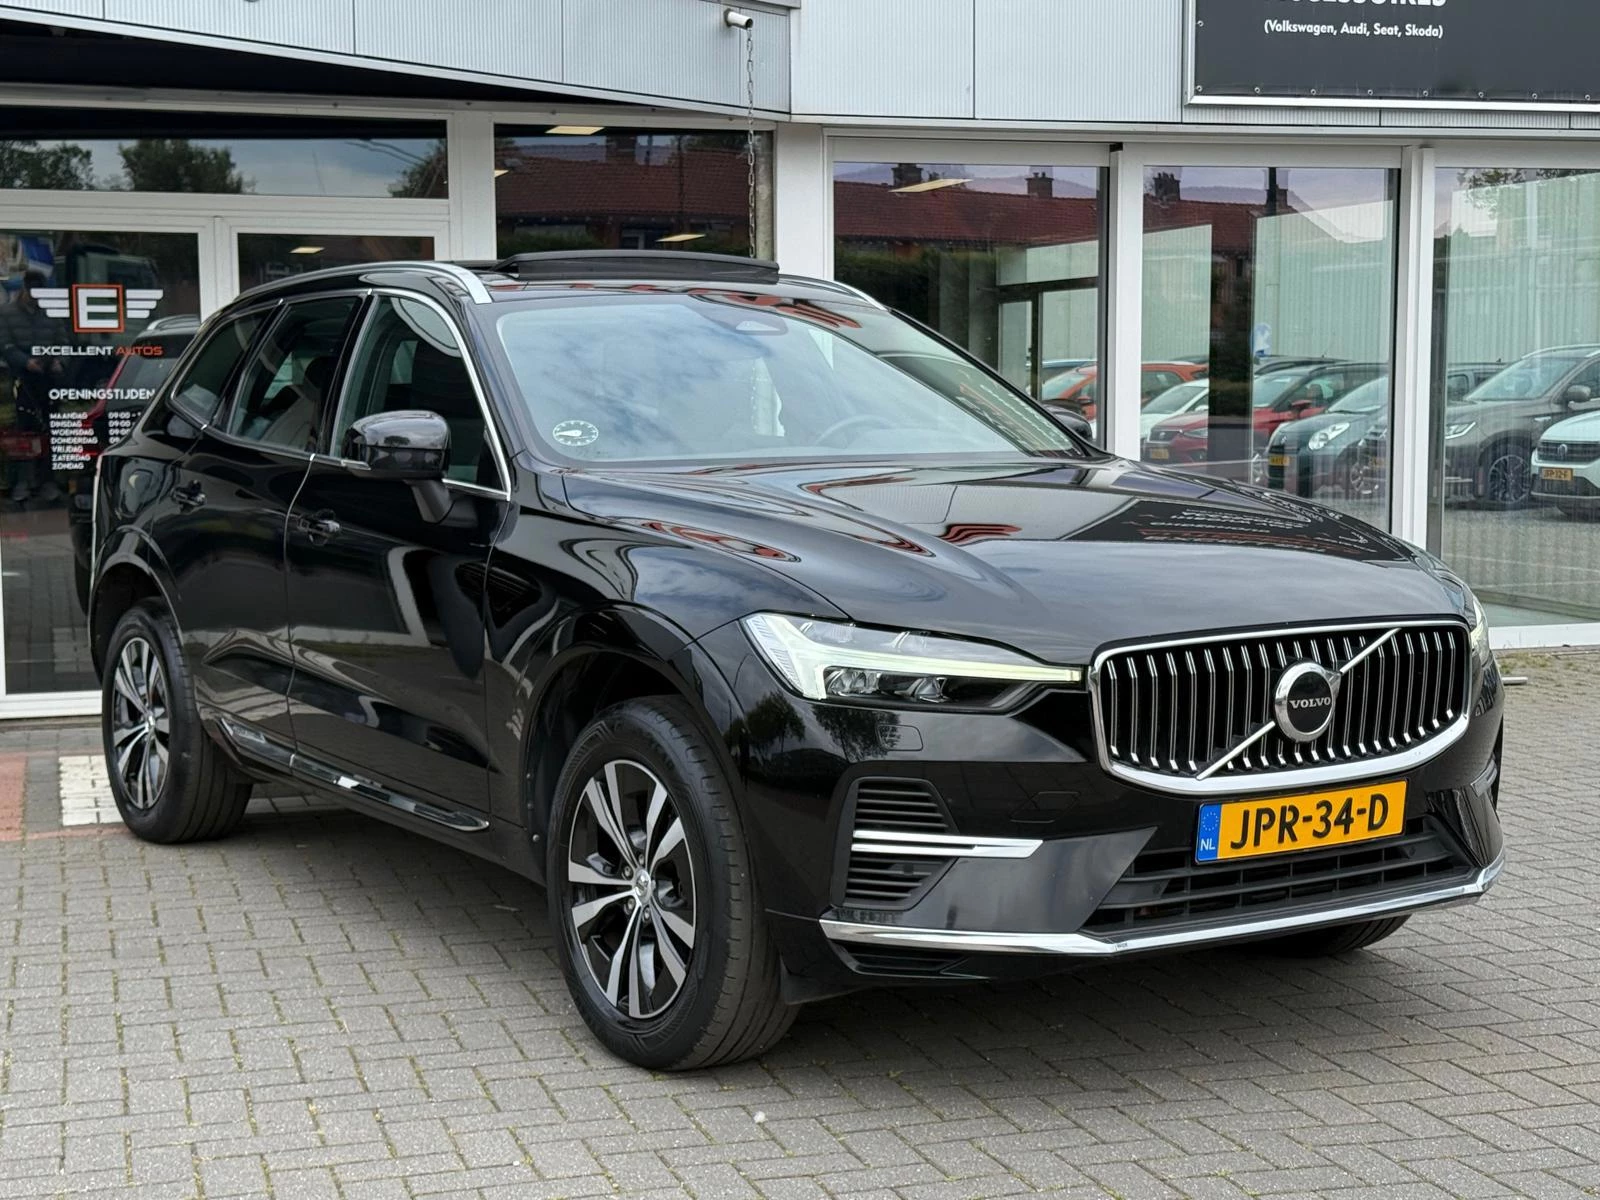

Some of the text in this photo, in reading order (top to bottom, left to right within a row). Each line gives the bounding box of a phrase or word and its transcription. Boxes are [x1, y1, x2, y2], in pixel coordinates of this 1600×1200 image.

[1264, 19, 1443, 39] (Volkswagen, Audi, Seat, Skoda)
[76, 288, 119, 328] E
[31, 345, 163, 356] EXCELLENT AUTOS
[48, 388, 155, 400] OPENINGSTIJDEN
[49, 412, 88, 420] MAANDAG
[49, 420, 82, 428] DINSDAG
[50, 428, 94, 436] WOENSDAG
[50, 436, 98, 444] DONDERDAG
[51, 445, 84, 453] VRIJDAG
[51, 453, 91, 462] ZATERDAG
[51, 462, 84, 470] ZONDAG
[1289, 696, 1331, 709] VOLVO
[1230, 793, 1389, 850] JPR-34-D
[1200, 838, 1216, 851] NL
